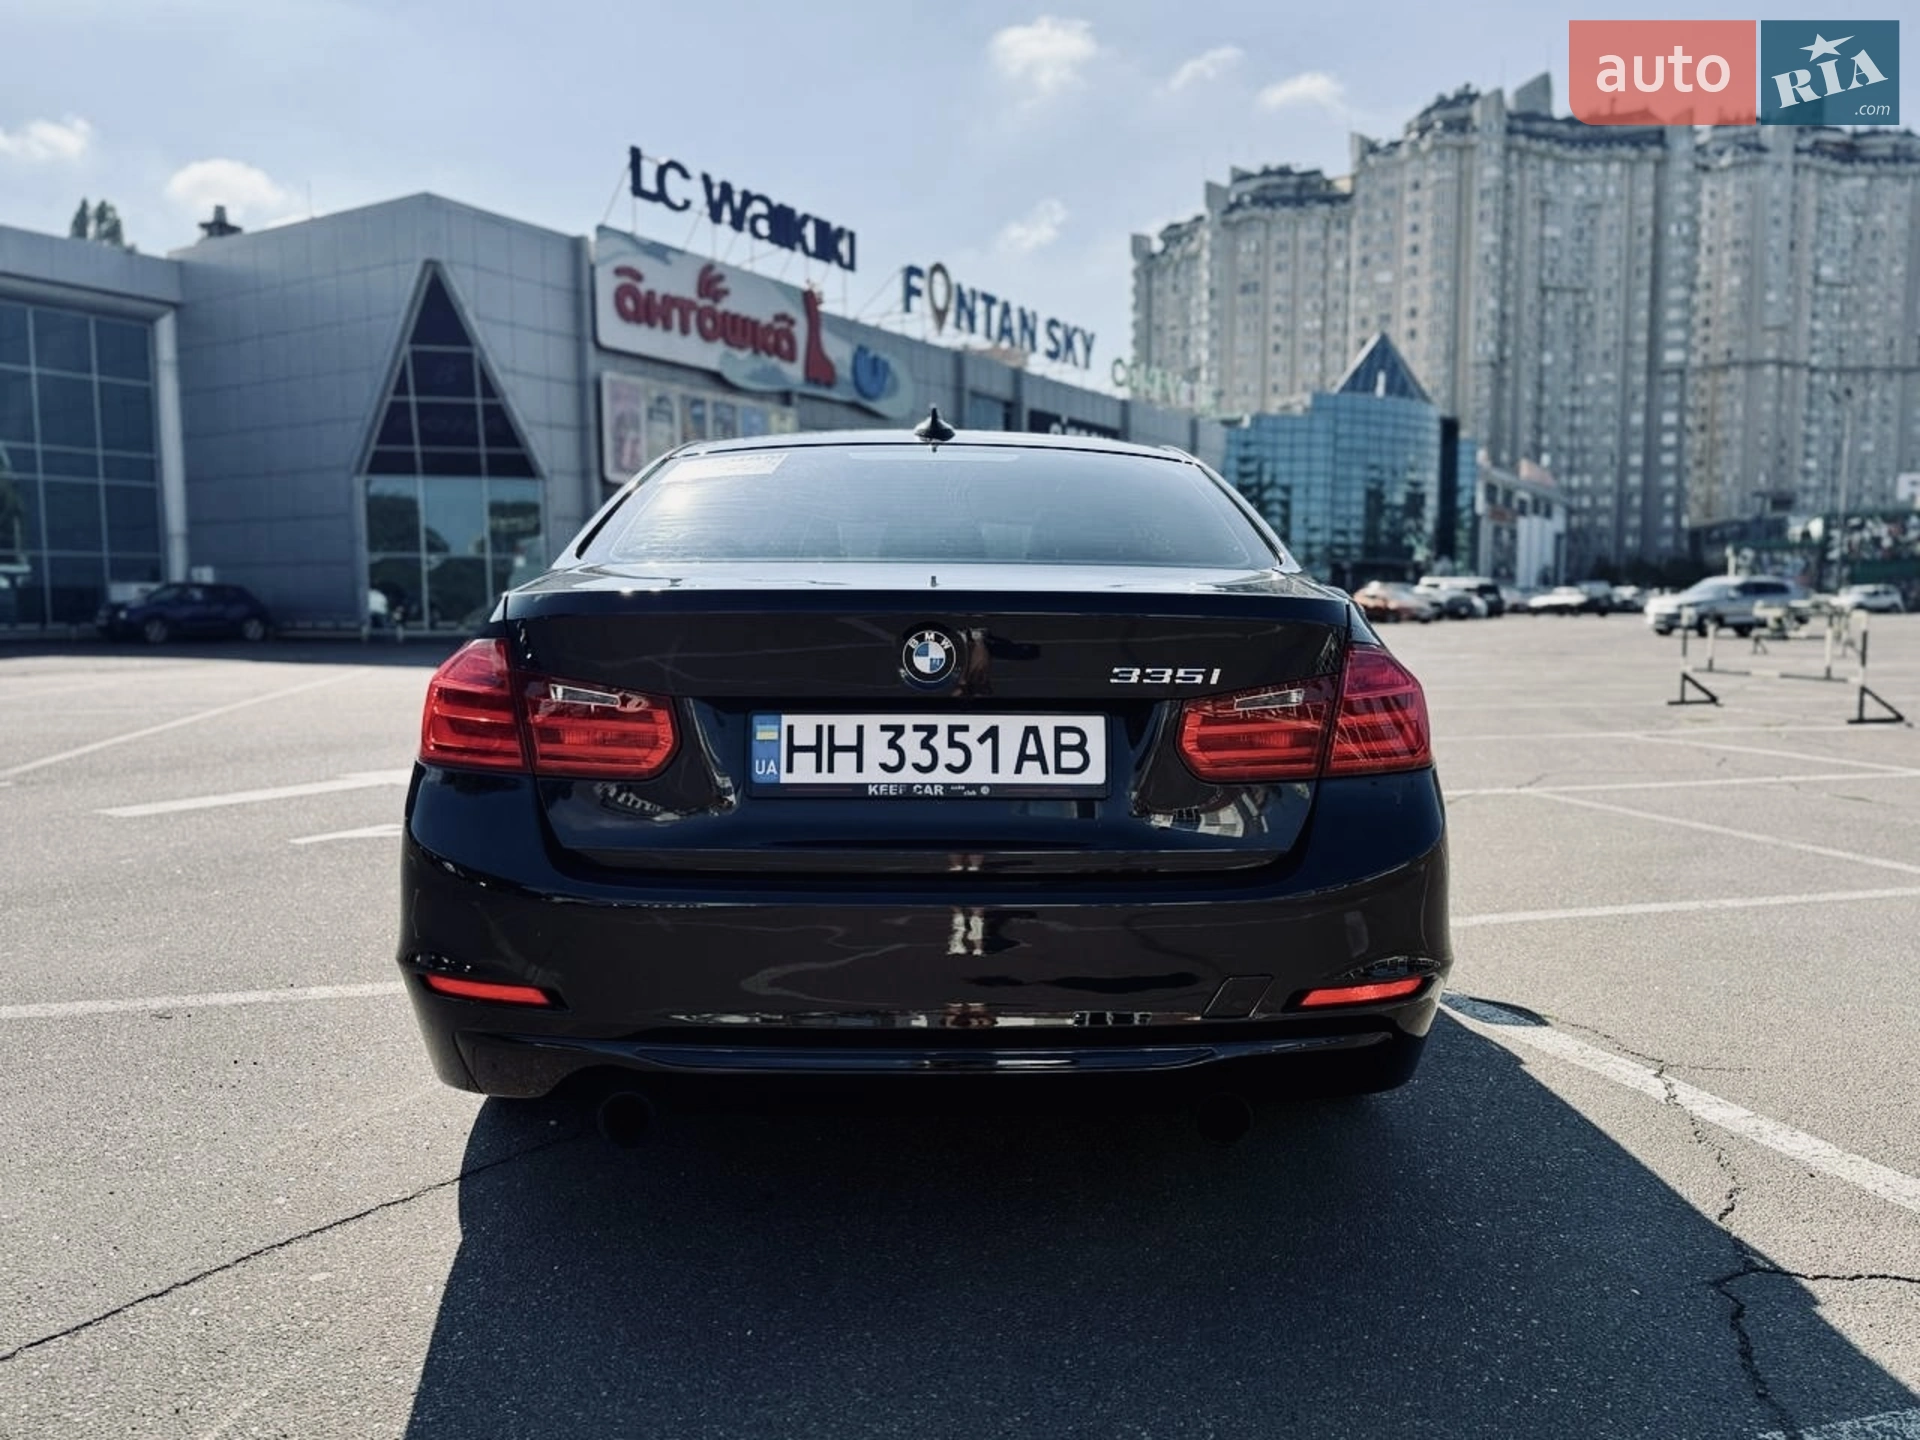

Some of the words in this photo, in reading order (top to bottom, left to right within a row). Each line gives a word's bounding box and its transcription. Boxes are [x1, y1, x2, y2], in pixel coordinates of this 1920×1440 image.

[630, 145, 691, 212] LC
[903, 262, 1038, 353] FONTAN
[1046, 317, 1095, 370] SKY
[755, 760, 777, 775] UA
[786, 724, 864, 773] HH
[879, 724, 999, 774] 3351
[1014, 725, 1090, 774] AB
[913, 784, 944, 796] CAR
